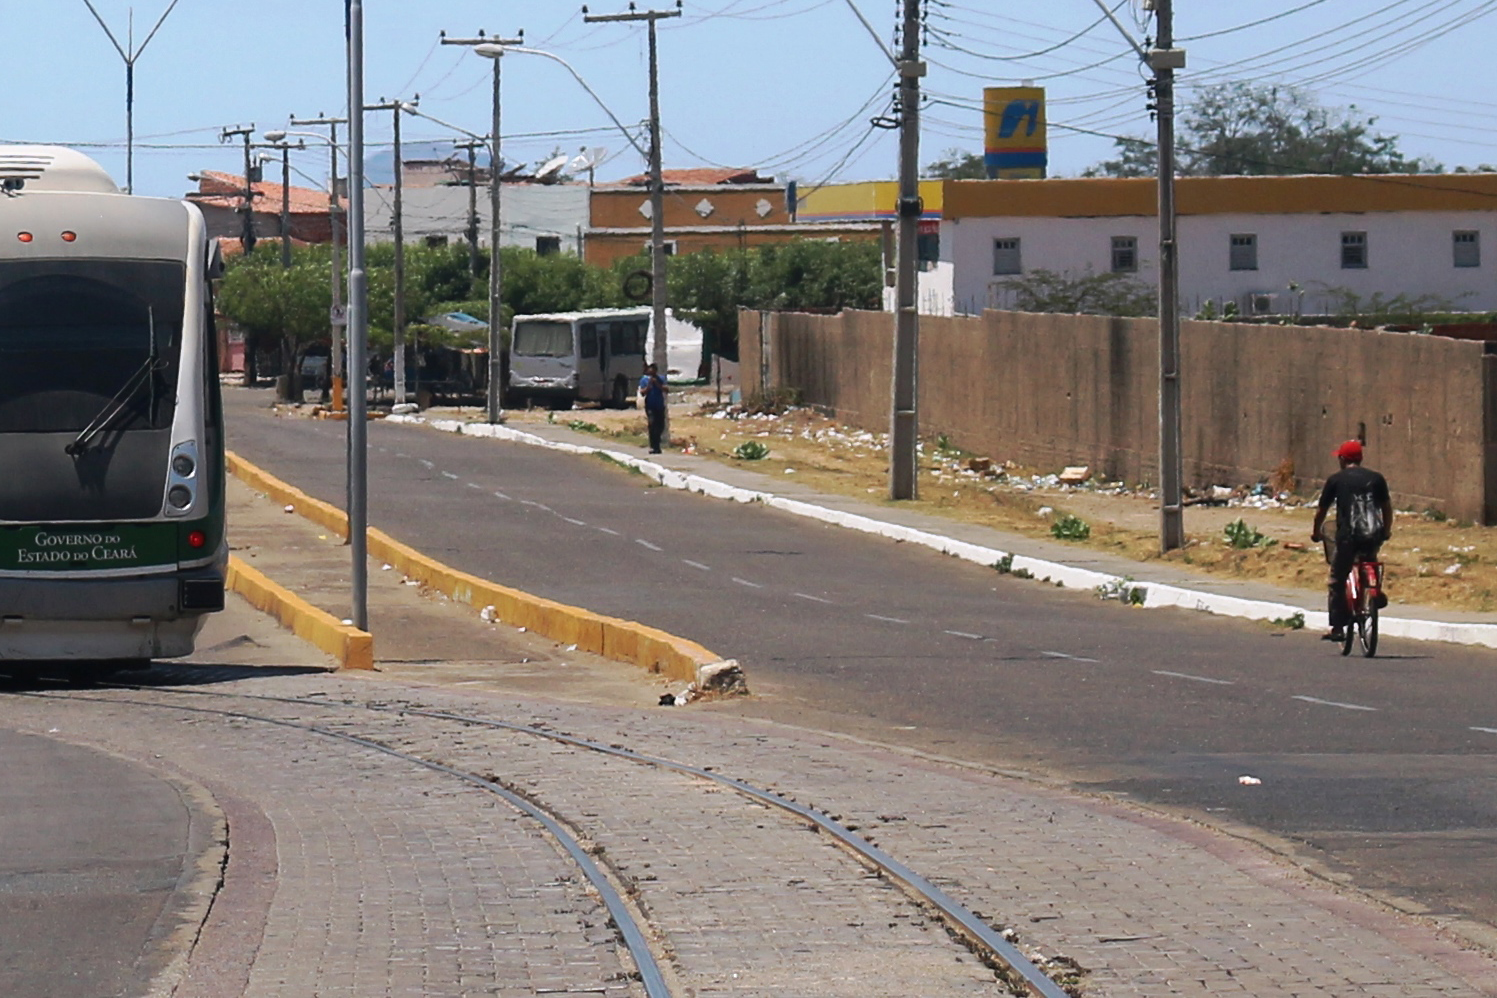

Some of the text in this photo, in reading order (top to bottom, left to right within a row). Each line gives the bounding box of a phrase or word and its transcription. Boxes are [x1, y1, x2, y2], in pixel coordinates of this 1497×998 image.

[34, 532, 102, 547] GOVERNO
[17, 548, 71, 562] ESTADO
[91, 544, 138, 561] CEARÁ
